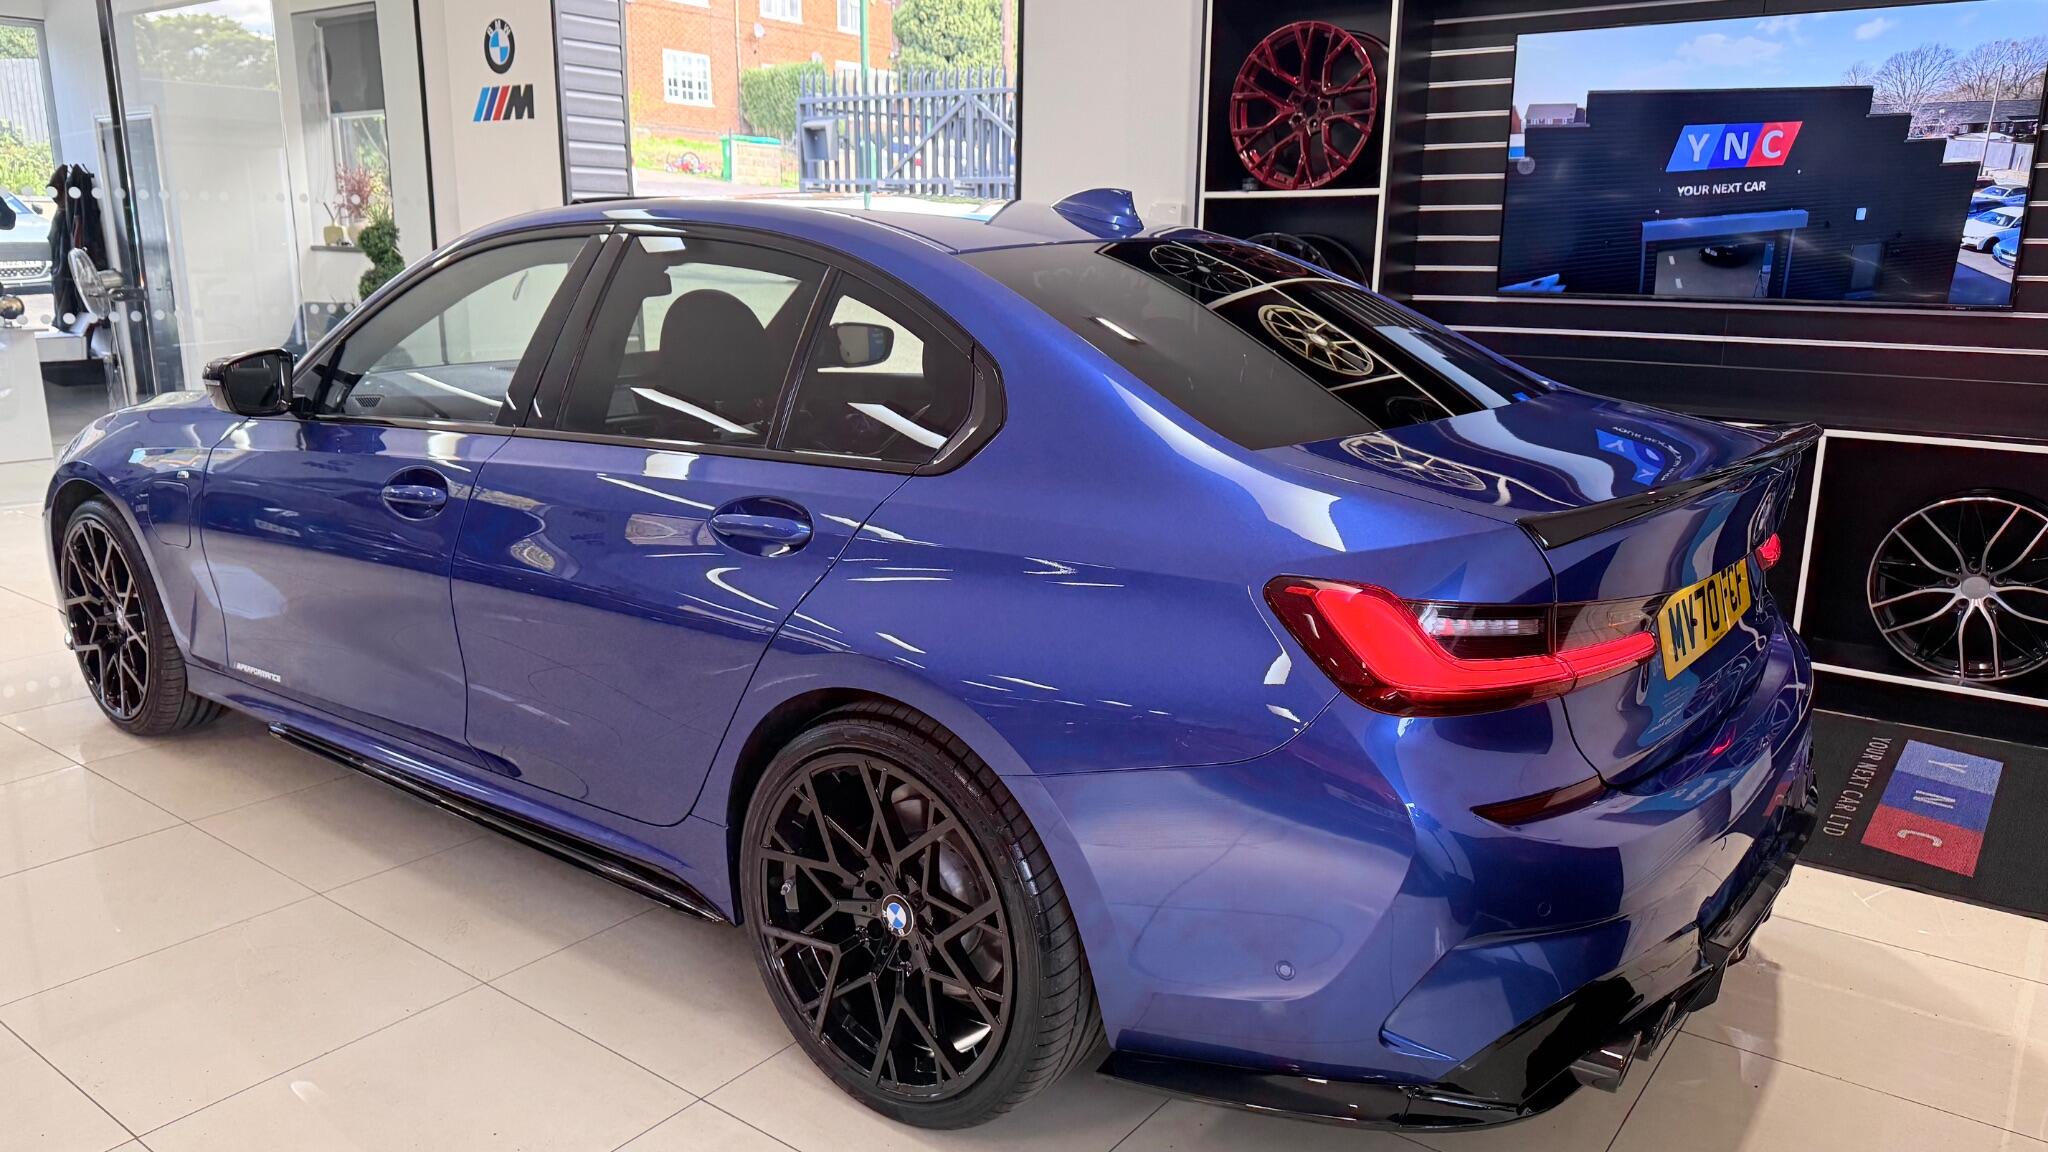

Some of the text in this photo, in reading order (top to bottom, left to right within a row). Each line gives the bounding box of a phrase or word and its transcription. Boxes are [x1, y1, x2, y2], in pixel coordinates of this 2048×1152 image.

[486, 19, 511, 37] BMW
[1687, 129, 1784, 162] YNC
[1677, 181, 1766, 196] YOUR NEXT CAR
[1668, 579, 1720, 662] MV70
[1822, 736, 1893, 838] YOUR NEXT CAR LTD
